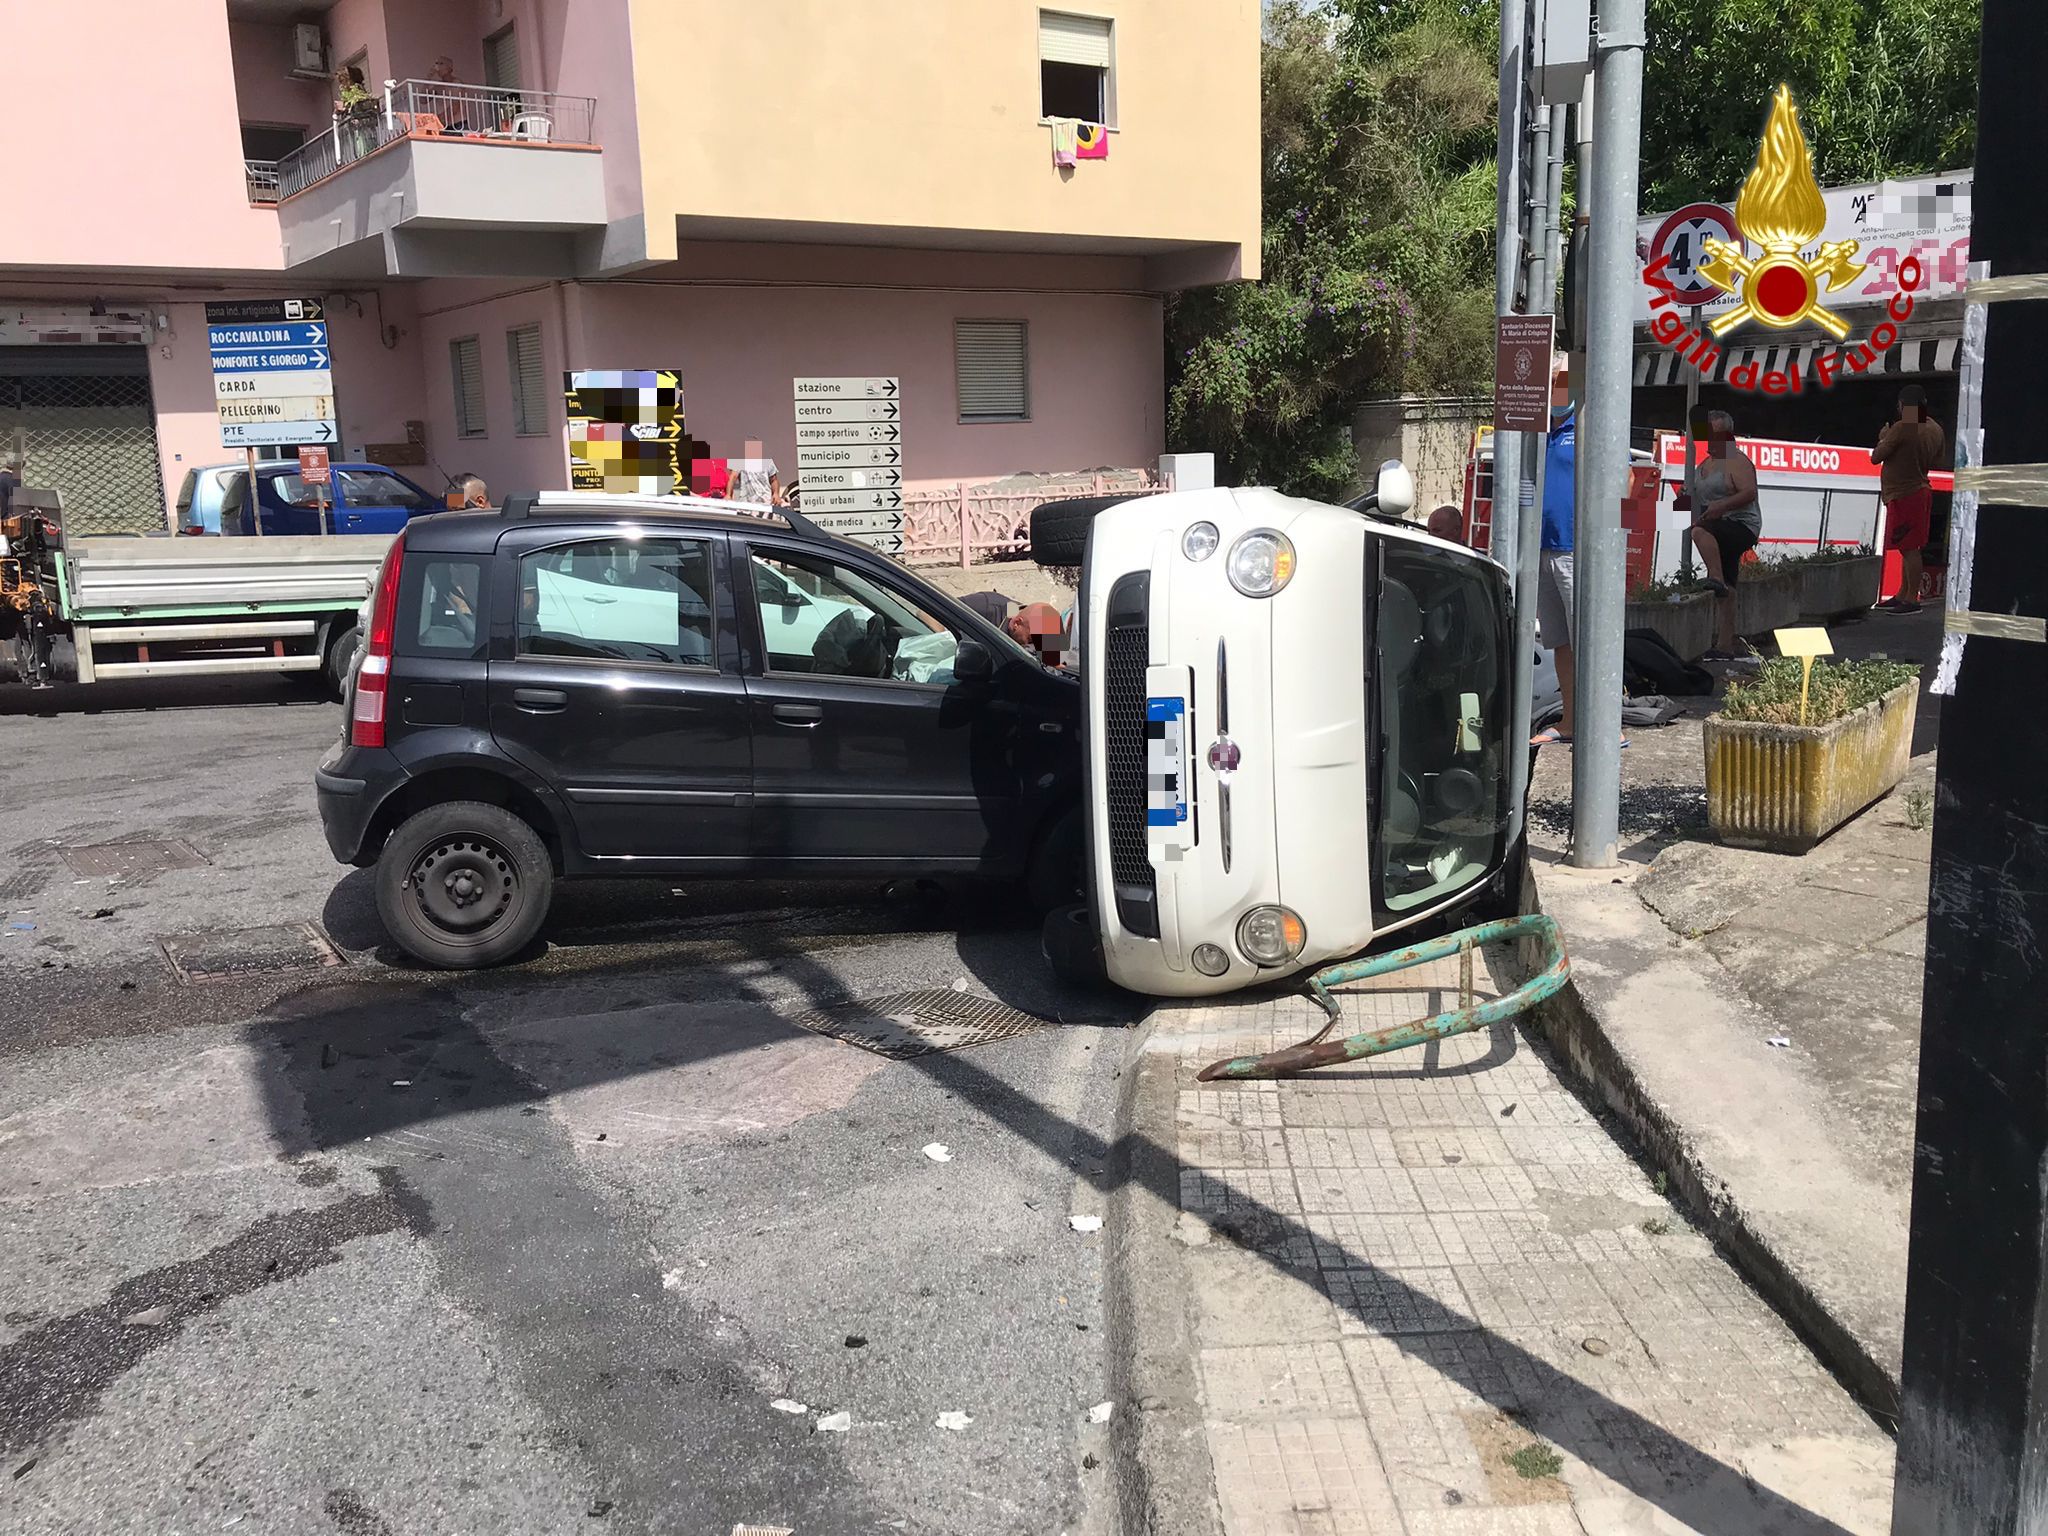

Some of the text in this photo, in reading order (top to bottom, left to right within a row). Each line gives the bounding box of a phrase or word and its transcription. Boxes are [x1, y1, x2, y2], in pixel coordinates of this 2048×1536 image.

[211, 330, 290, 343] ROCCAVALDINA
[212, 356, 259, 369] MONFORTE
[798, 384, 841, 392] stazione
[221, 405, 281, 417] PELLEGRINO
[798, 405, 833, 415] centro
[223, 426, 245, 435] PTE
[800, 427, 859, 439] campo sportivo
[800, 451, 851, 461] municipio
[1760, 446, 1788, 467] DEL
[1792, 449, 1840, 471] FUOCO
[801, 474, 844, 484] cimitero
[804, 495, 855, 507] vigili urbani
[836, 517, 864, 527] medica
